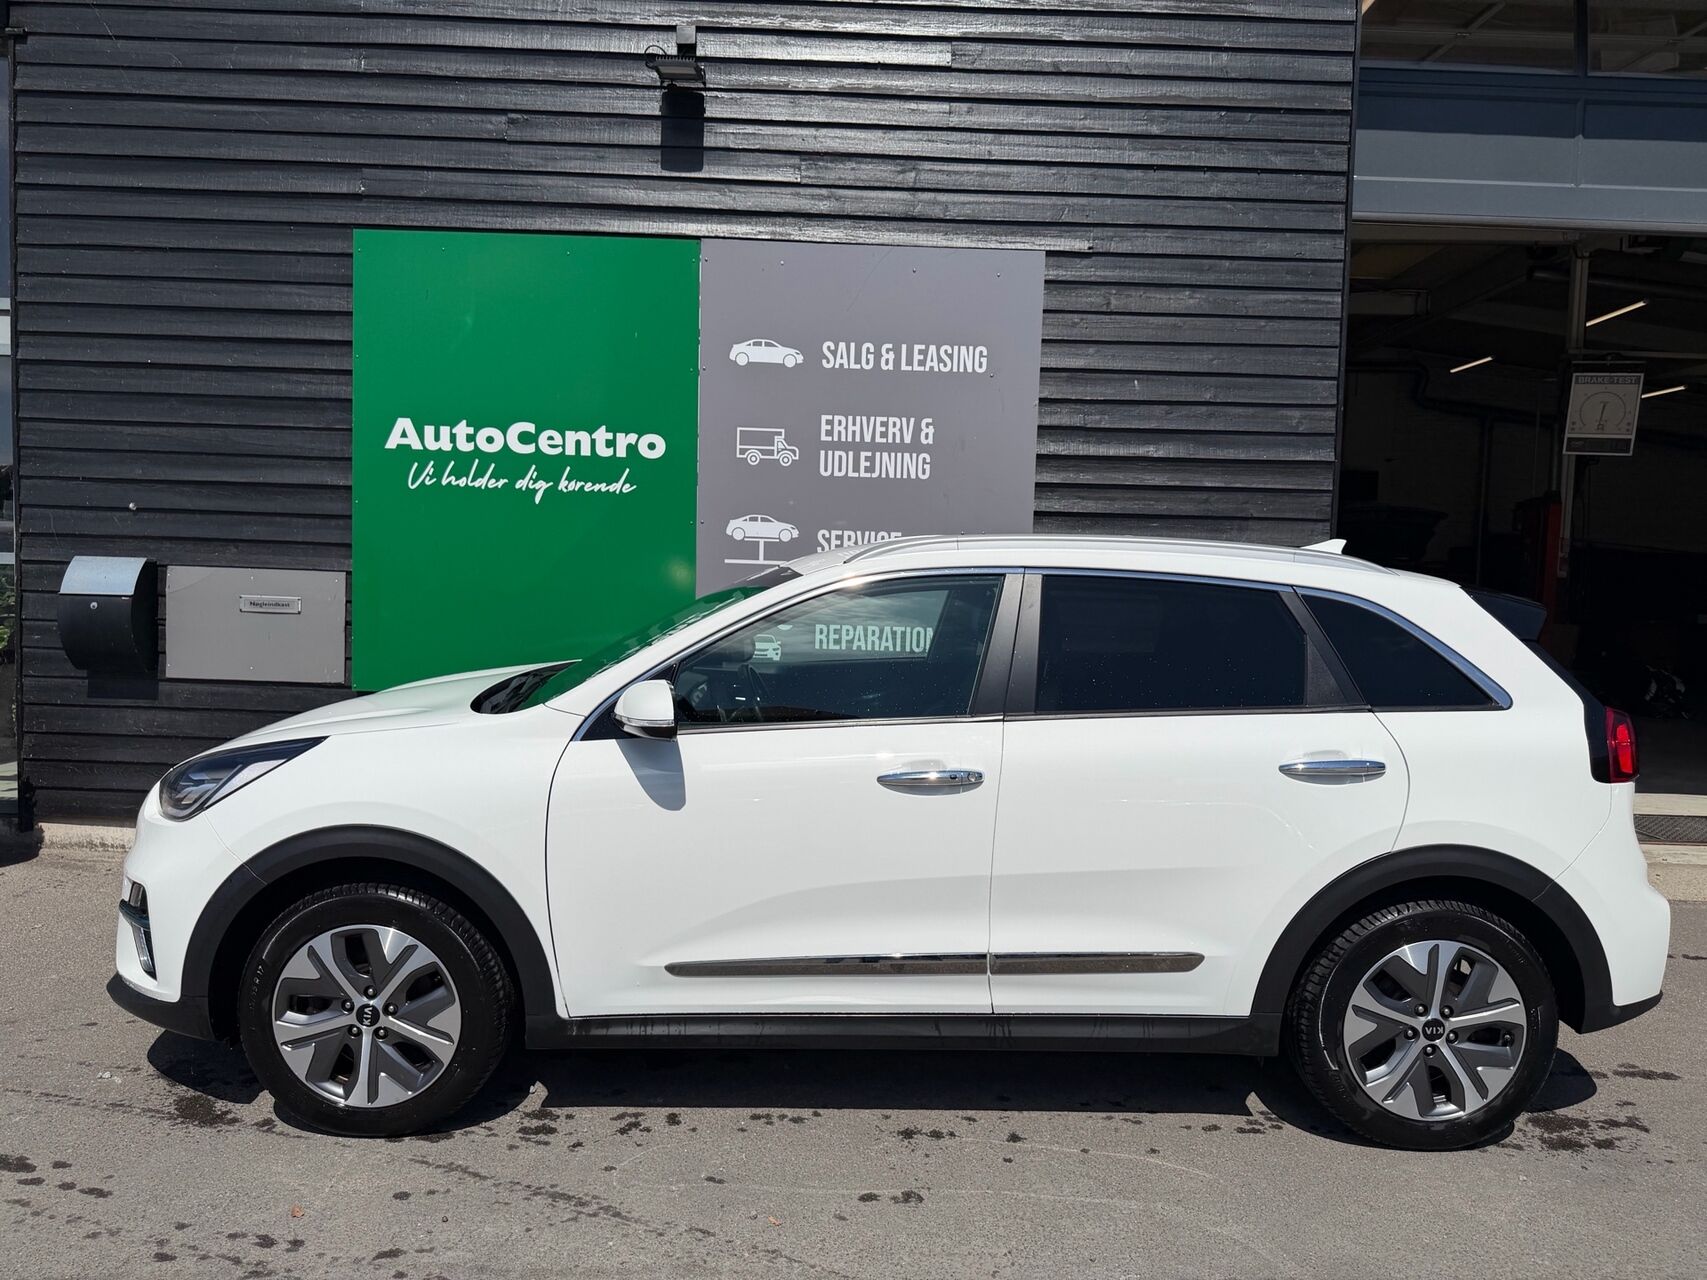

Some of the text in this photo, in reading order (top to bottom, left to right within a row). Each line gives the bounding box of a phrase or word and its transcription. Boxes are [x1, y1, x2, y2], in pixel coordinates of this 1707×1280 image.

[821, 340, 989, 374] SALG & LEASING
[384, 417, 667, 459] AutoCentro
[820, 414, 935, 445] ERHVERV &
[818, 450, 931, 480] UDLEJNING
[407, 458, 636, 505] Vi holder dig kørende
[363, 1007, 373, 1026] KIA
[1424, 1026, 1444, 1035] KIA
